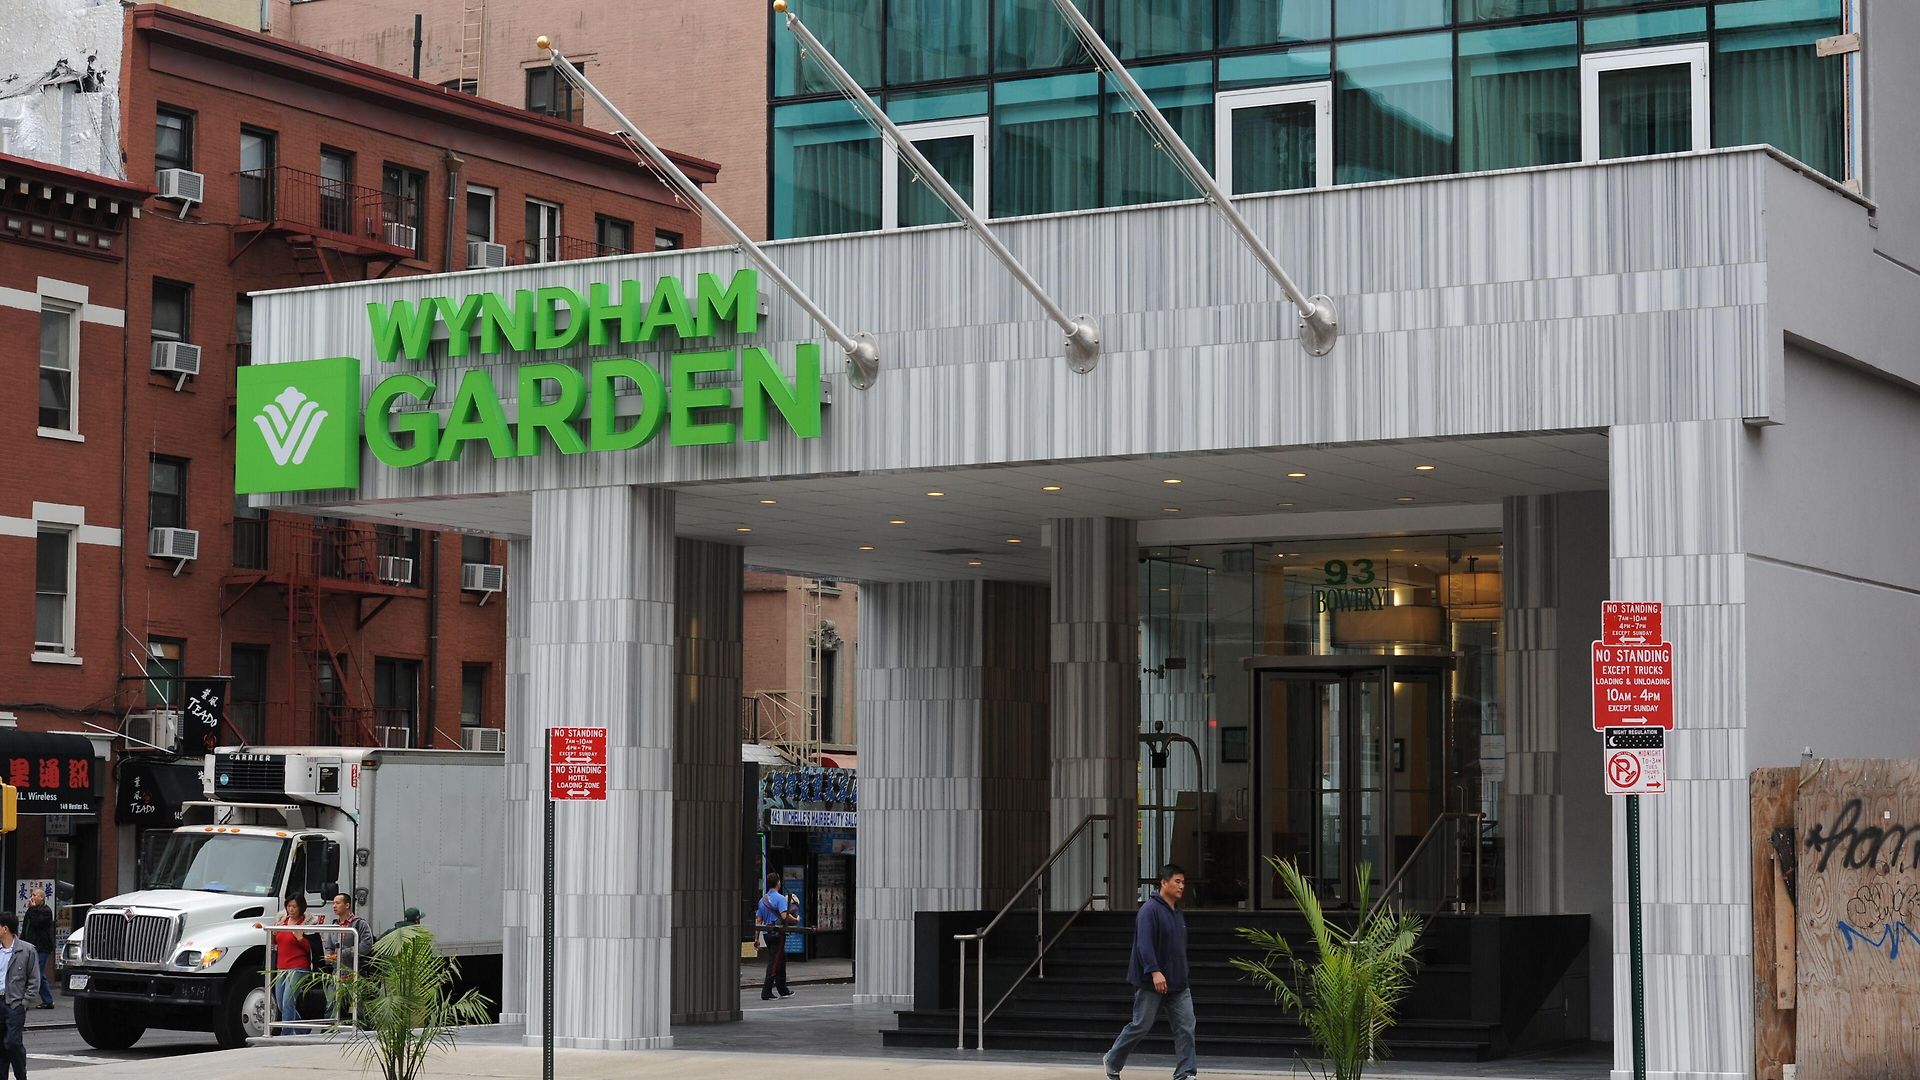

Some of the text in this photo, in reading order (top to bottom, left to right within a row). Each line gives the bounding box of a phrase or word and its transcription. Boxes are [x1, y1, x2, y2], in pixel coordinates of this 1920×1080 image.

[367, 268, 758, 362] WYNDHAM
[364, 343, 821, 468] GARDEN
[1324, 558, 1376, 585] 93
[1316, 587, 1386, 613] BOWERY
[1606, 604, 1658, 613] NO STANDING
[1596, 650, 1669, 662] NO STANDING
[1602, 666, 1663, 674] EXCEPT TRUCKS
[1606, 688, 1632, 701] 10AM
[1640, 688, 1660, 701] 4PM
[188, 697, 218, 727] TEADO
[568, 729, 603, 737] STANDING
[28, 792, 57, 800] Wireless
[130, 802, 155, 813] TEADO
[772, 810, 780, 824] 143
[783, 810, 810, 825] MICHELLE'S
